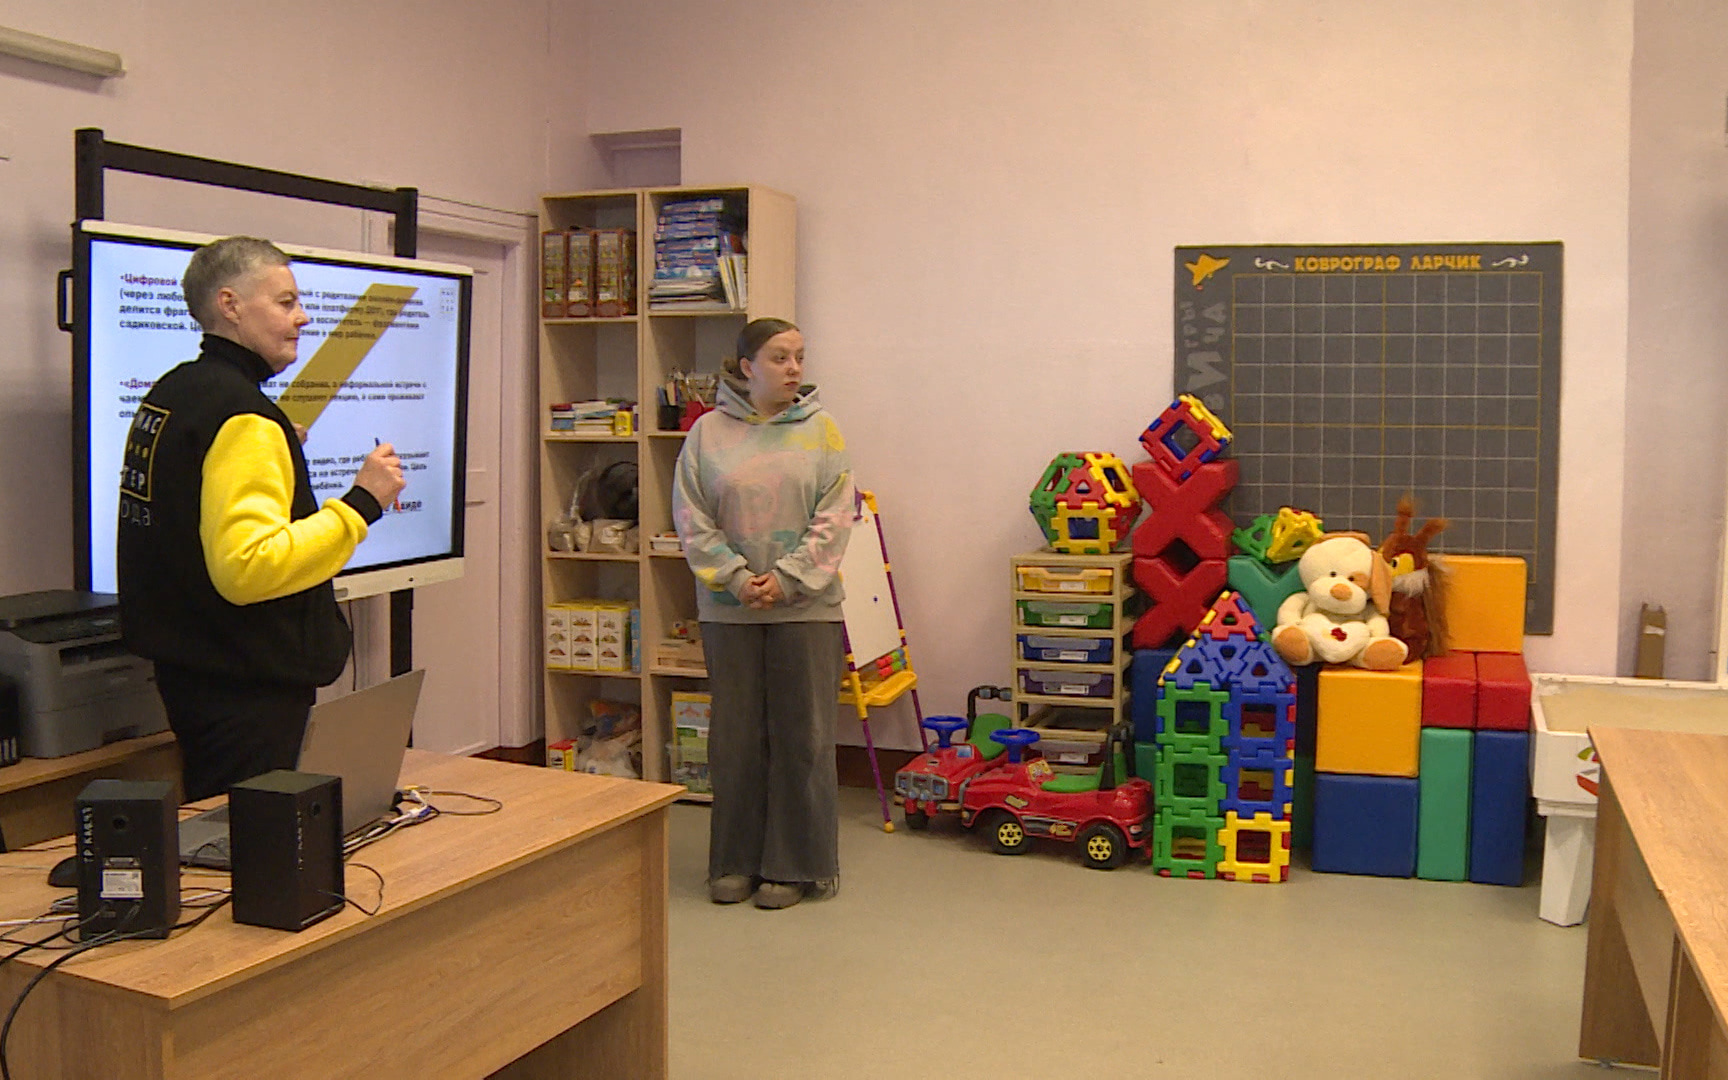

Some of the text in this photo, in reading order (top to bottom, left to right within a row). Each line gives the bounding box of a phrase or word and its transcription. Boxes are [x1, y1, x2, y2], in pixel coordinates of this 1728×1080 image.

[1294, 255, 1482, 273] КОВРОГРАФ ЛАРЧИК
[157, 291, 184, 301] любо
[163, 306, 188, 318] фраг
